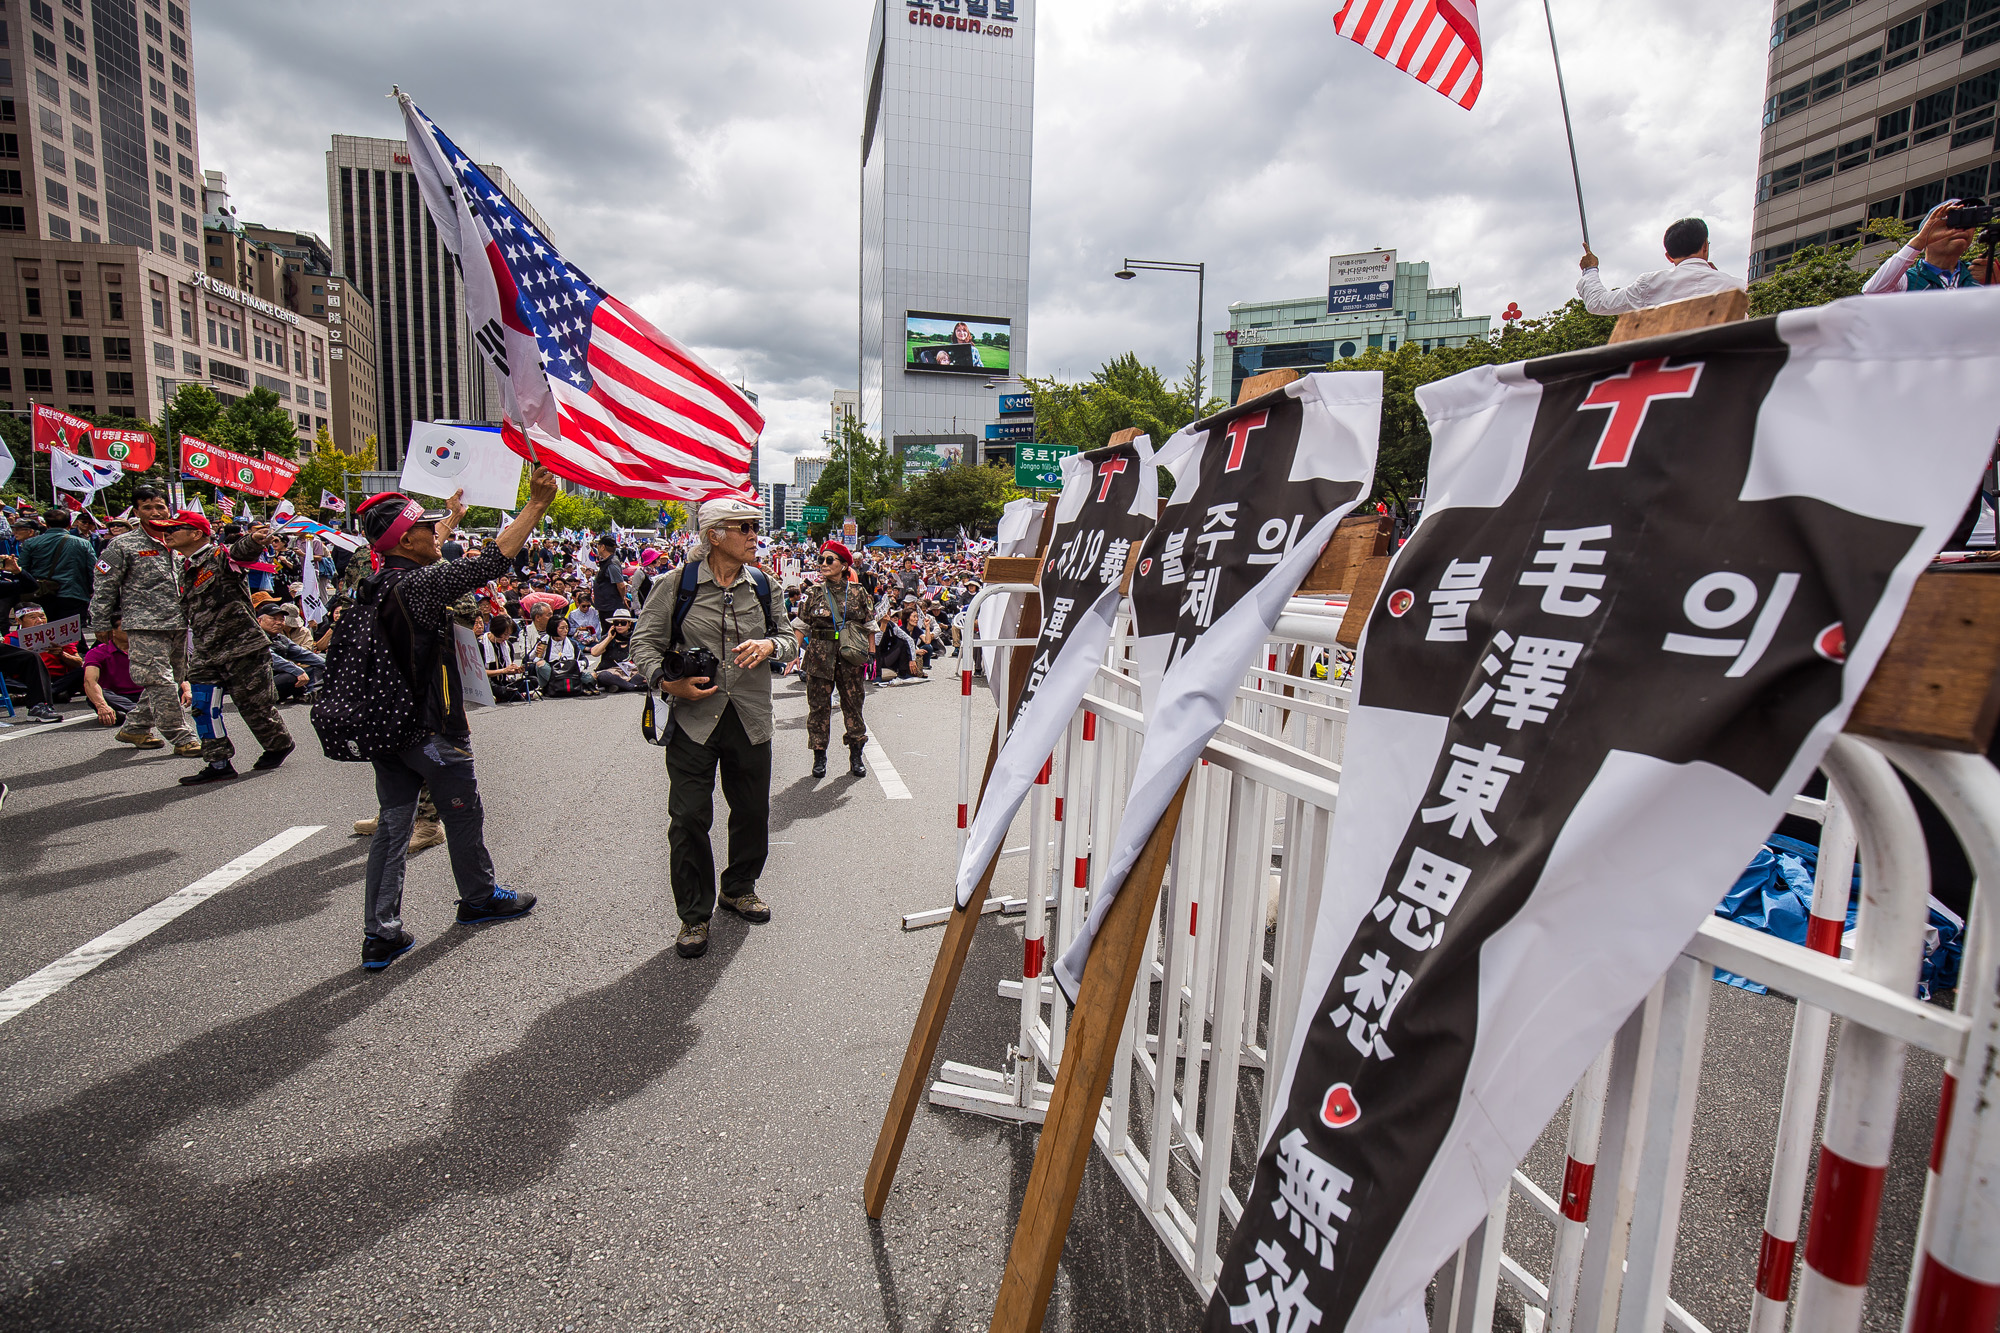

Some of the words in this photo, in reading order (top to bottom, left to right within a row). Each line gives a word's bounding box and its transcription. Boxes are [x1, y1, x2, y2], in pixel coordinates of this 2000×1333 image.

[908, 8, 1014, 38] chosun.com
[1338, 264, 1387, 276] 캐나다문화어학원
[1333, 295, 1362, 304] TOEFL
[1363, 292, 1389, 301] 시험센터
[1020, 462, 1040, 472] Jongno
[1047, 474, 1054, 482] 6
[1160, 527, 1189, 586] 불
[1246, 513, 1303, 566] 의
[1425, 555, 1493, 643] 불
[1661, 569, 1801, 678] 의
[23, 627, 56, 647] 문재인
[60, 620, 79, 636] 퇴진
[1329, 523, 1612, 1062] 毛澤東思想
